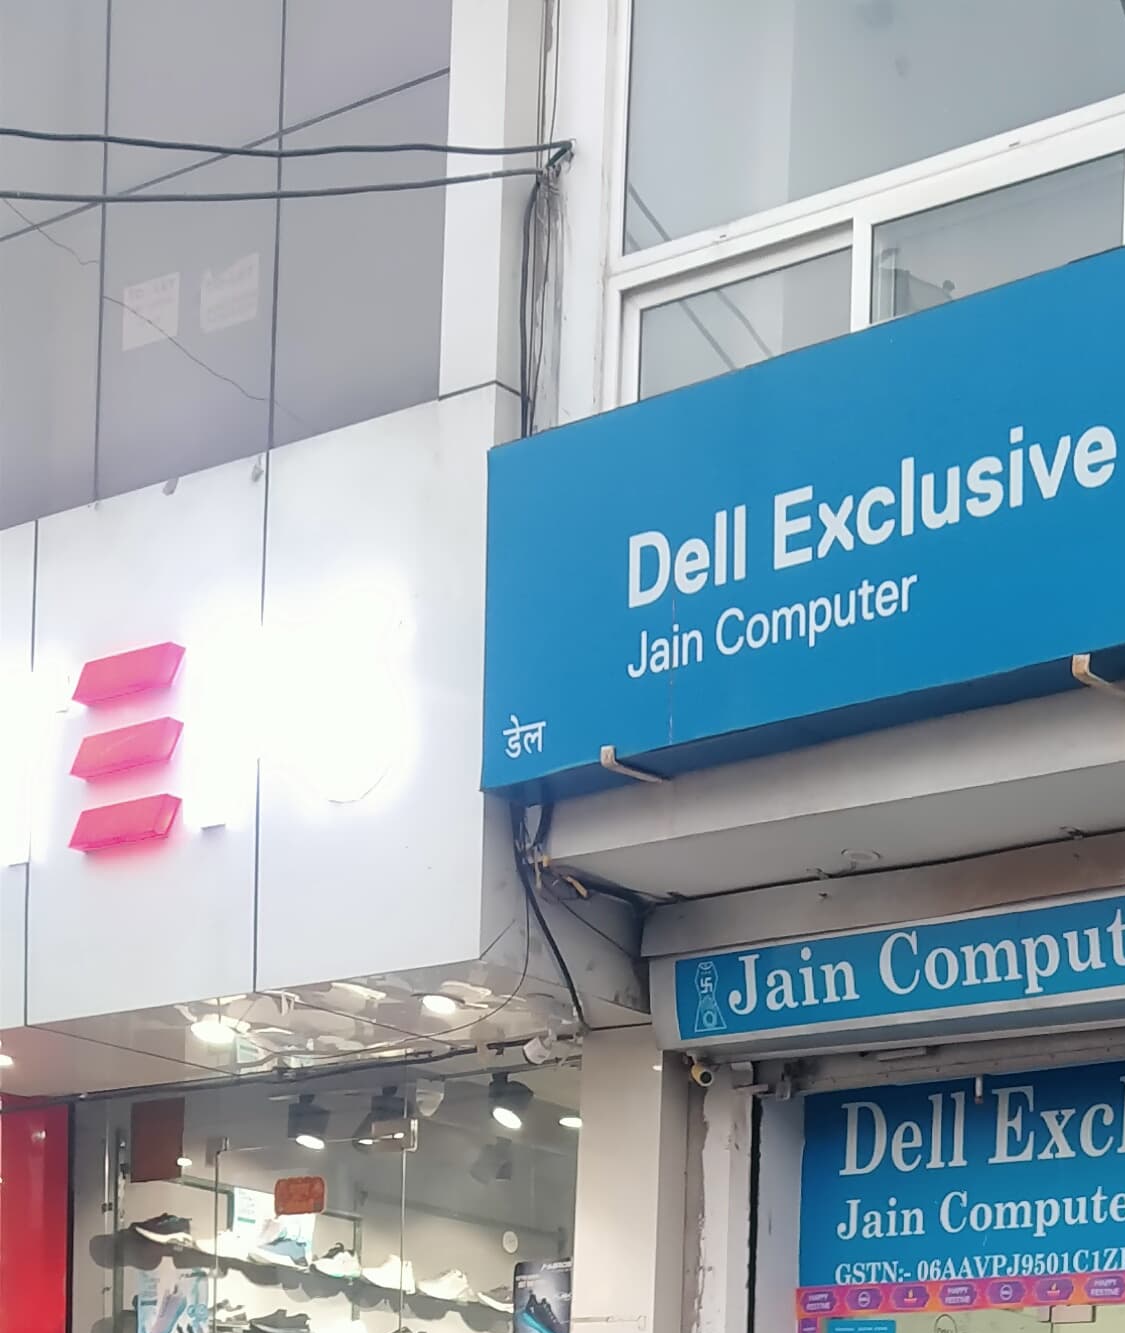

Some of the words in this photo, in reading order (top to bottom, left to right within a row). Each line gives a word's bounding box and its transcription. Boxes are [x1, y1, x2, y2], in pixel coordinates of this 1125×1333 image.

[627, 505, 748, 610] Dell
[773, 425, 1118, 571] Exclusive
[627, 623, 704, 679] Jain
[714, 573, 919, 656] Computer
[502, 713, 547, 759] डेल
[728, 946, 861, 1016] Jain
[838, 1083, 969, 1177] Dell
[836, 1196, 926, 1241] Jain
[834, 1260, 912, 1286] GSTN:-
